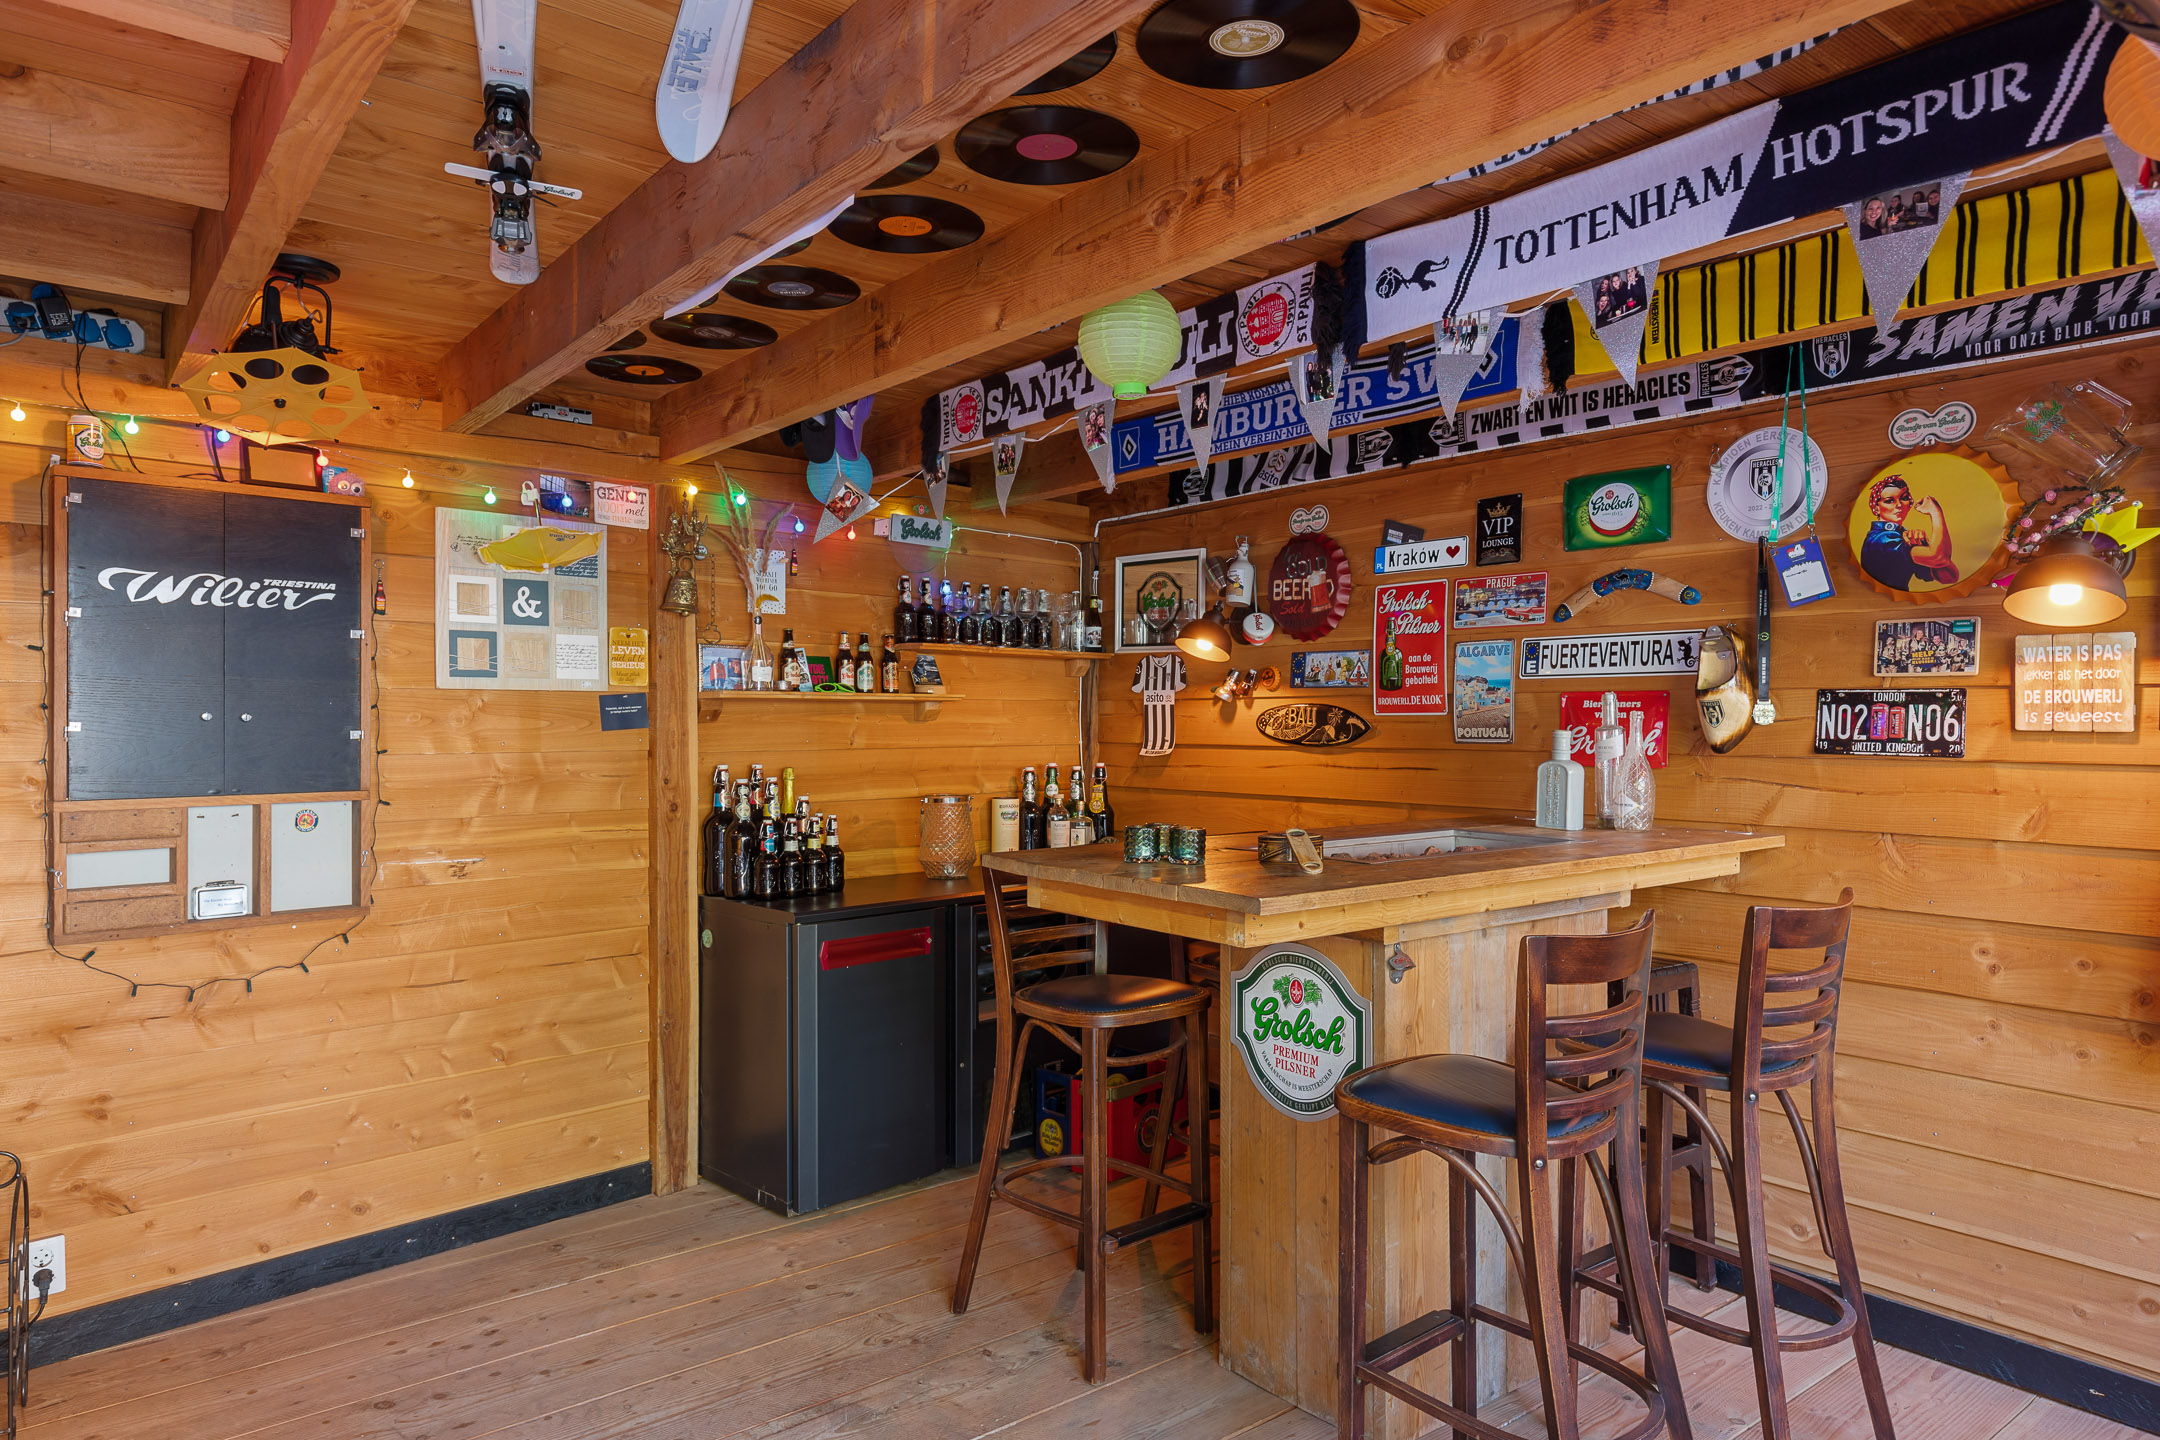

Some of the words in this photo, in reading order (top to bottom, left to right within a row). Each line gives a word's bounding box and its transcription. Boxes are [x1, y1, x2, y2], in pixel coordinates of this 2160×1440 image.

[1493, 152, 1745, 271] TOTTENHAM
[1771, 61, 2032, 180] HOTSPUR
[1287, 300, 1295, 327] 1910
[1864, 285, 2081, 368] SAMEN
[1964, 341, 2001, 359] VOOR
[2009, 330, 2047, 349] ONZE
[2054, 320, 2099, 342] CLUB.
[2108, 310, 2152, 331] VOOR
[1815, 332, 1848, 345] HERACLES
[1701, 363, 1710, 397] HERACLES
[1471, 411, 1522, 434] ZWART
[1525, 402, 1545, 423] EN
[1548, 394, 1578, 421] WIT
[1582, 391, 1600, 413] IS
[1603, 371, 1691, 410] HERACLES
[942, 394, 950, 445] ST.PAULI
[1895, 423, 1922, 435] Rondje
[1937, 414, 1967, 428] Grolsch
[1215, 439, 1241, 453] MEIN
[1336, 411, 1361, 425] HSV
[1752, 459, 1779, 468] HERACLES
[1258, 469, 1280, 486] asito
[626, 506, 645, 516] met
[1591, 492, 1635, 516] Grolsch
[1482, 516, 1514, 535] VIP
[1713, 501, 1742, 533] KEUKEN
[901, 518, 942, 540] Grolsch
[1482, 537, 1514, 548] LOUNGE
[1286, 556, 1327, 578] COLD
[1389, 547, 1440, 568] Kraków
[97, 566, 336, 611] Wilier
[263, 578, 337, 591] TRIESTINA
[1273, 578, 1312, 601] BEER
[1486, 576, 1517, 589] PRAGUE
[1143, 592, 1176, 611] Grolsch
[1280, 601, 1305, 615] Sold
[1379, 589, 1433, 614] Grolsch-
[1394, 612, 1441, 635] Pilsner
[611, 646, 645, 655] LEVEN
[1409, 655, 1422, 663] aan
[1423, 653, 1432, 662] de
[1458, 644, 1511, 658] ALGARVE
[1540, 638, 1675, 671] FUERTEVENTURA
[1911, 650, 1934, 658] HELP
[2023, 646, 2072, 663] WATER
[2076, 644, 2089, 662] IS
[2093, 643, 2122, 661] PAS
[1405, 664, 1438, 675] Brouwerij
[1526, 661, 1537, 674] E
[2023, 669, 2055, 681] lekker
[2057, 668, 2072, 680] als
[2074, 668, 2093, 680] het
[2095, 667, 2122, 680] door
[1405, 675, 1438, 687] gebotteld
[1146, 692, 1164, 702] asito
[1411, 696, 1421, 705] DE
[1873, 692, 1905, 702] LONDON
[2024, 689, 2041, 704] DE
[2045, 688, 2123, 704] BROUWERIJ
[1288, 707, 1317, 726] BALI
[2025, 709, 2038, 723] is
[2043, 710, 2123, 725] geweest
[1457, 726, 1510, 739] PORTUGAL
[1819, 742, 1828, 750] 19
[1852, 741, 1882, 752] UNITED
[1886, 742, 1924, 753] KINGDOM
[1262, 954, 1289, 971] GROLSCHE
[1289, 954, 1335, 985] BIERBROUWERIJ
[1251, 997, 1345, 1055] Grolsch
[1273, 1044, 1320, 1067] PREMIUM
[1261, 1050, 1292, 1089] VAKMANSCHAP
[1275, 1057, 1316, 1079] PILSNER
[1262, 1077, 1295, 1108] NATUURLIJK
[1294, 1101, 1319, 1111] GERIJPT
[1320, 1096, 1335, 1108] BIER
